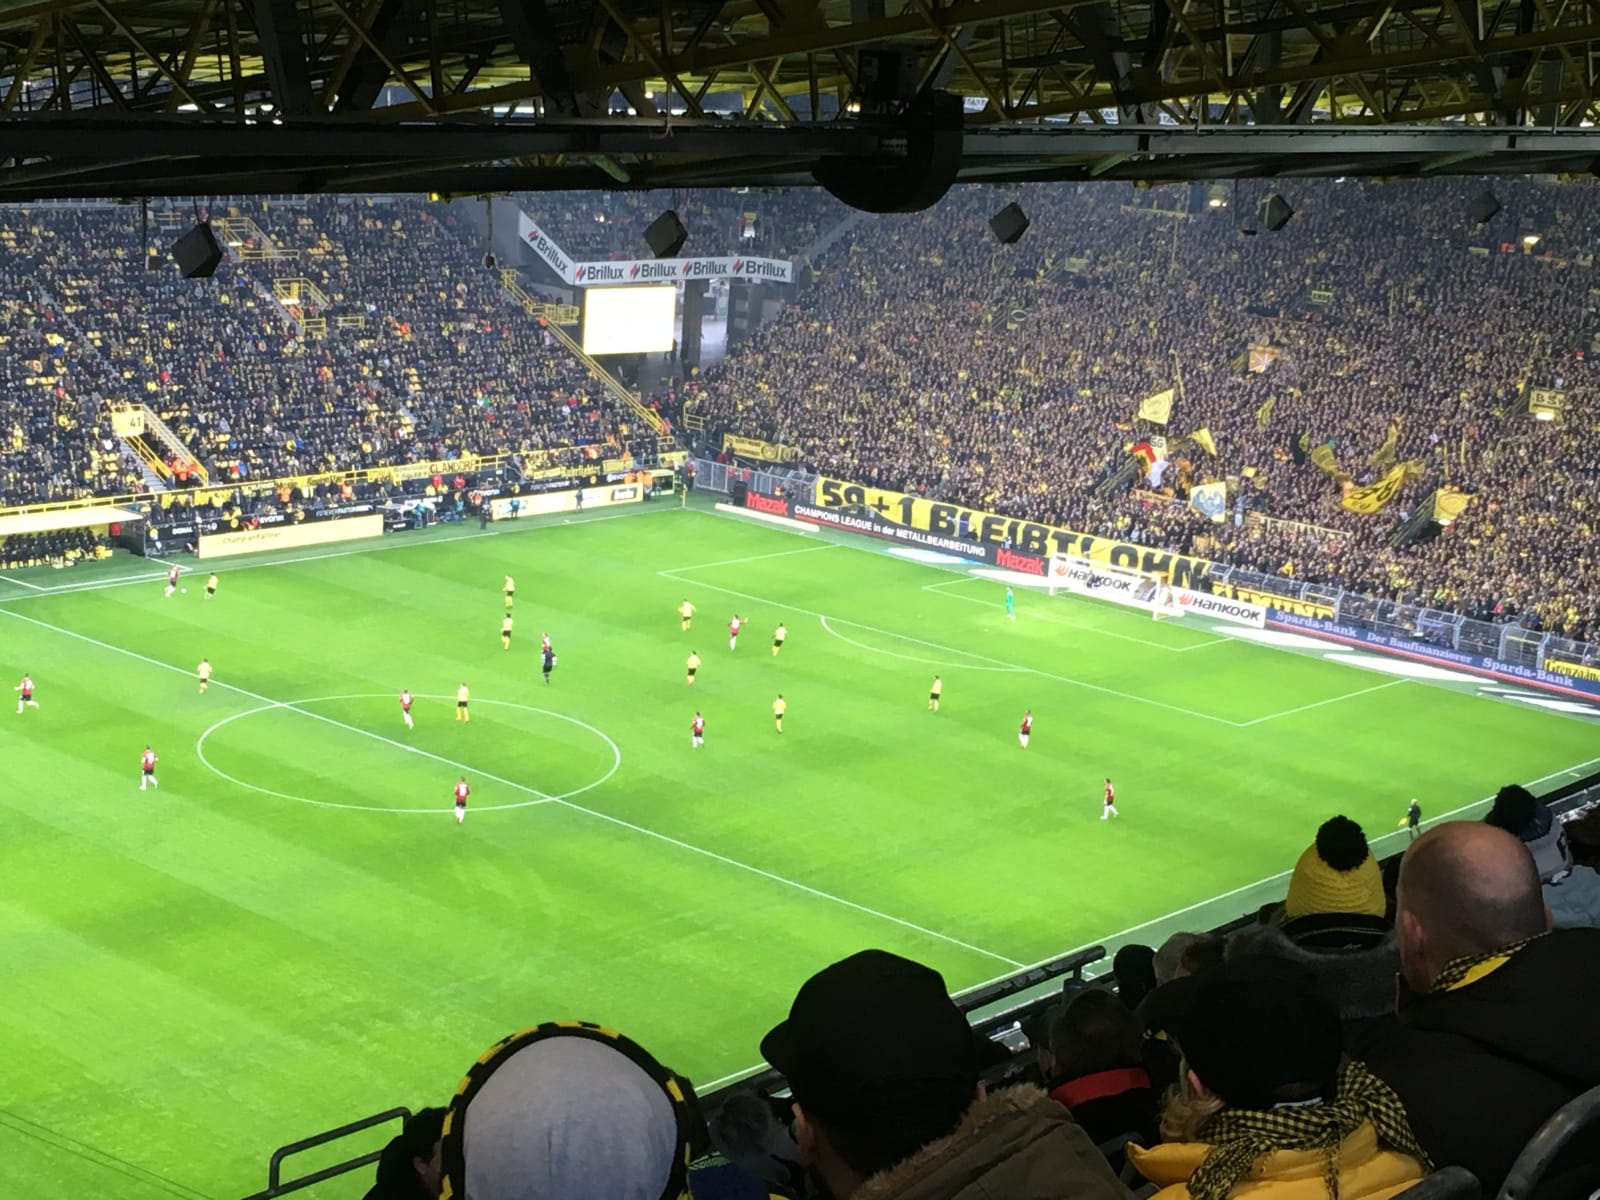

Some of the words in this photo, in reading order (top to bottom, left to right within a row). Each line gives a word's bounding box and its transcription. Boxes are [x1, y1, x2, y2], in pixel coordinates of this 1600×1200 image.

[537, 237, 569, 275] Brillux
[587, 266, 624, 280] Brillux
[641, 264, 676, 278] Brillux
[693, 261, 727, 275] Brillux
[745, 260, 786, 278] Brillux
[129, 416, 141, 427] 41
[746, 491, 788, 516] Mazak
[794, 504, 840, 522] CHAMPIONS
[840, 513, 873, 530] LEAGUE
[874, 522, 881, 532] in
[882, 523, 896, 535] der
[896, 529, 986, 557] METALLBEARBEITUNG
[996, 547, 1044, 576] Mazak
[1275, 610, 1357, 638] Sparda-Bank
[1367, 631, 1387, 644] Der
[1389, 636, 1473, 665] Baufinanzierer
[1482, 657, 1574, 687] Sparda-Bank
